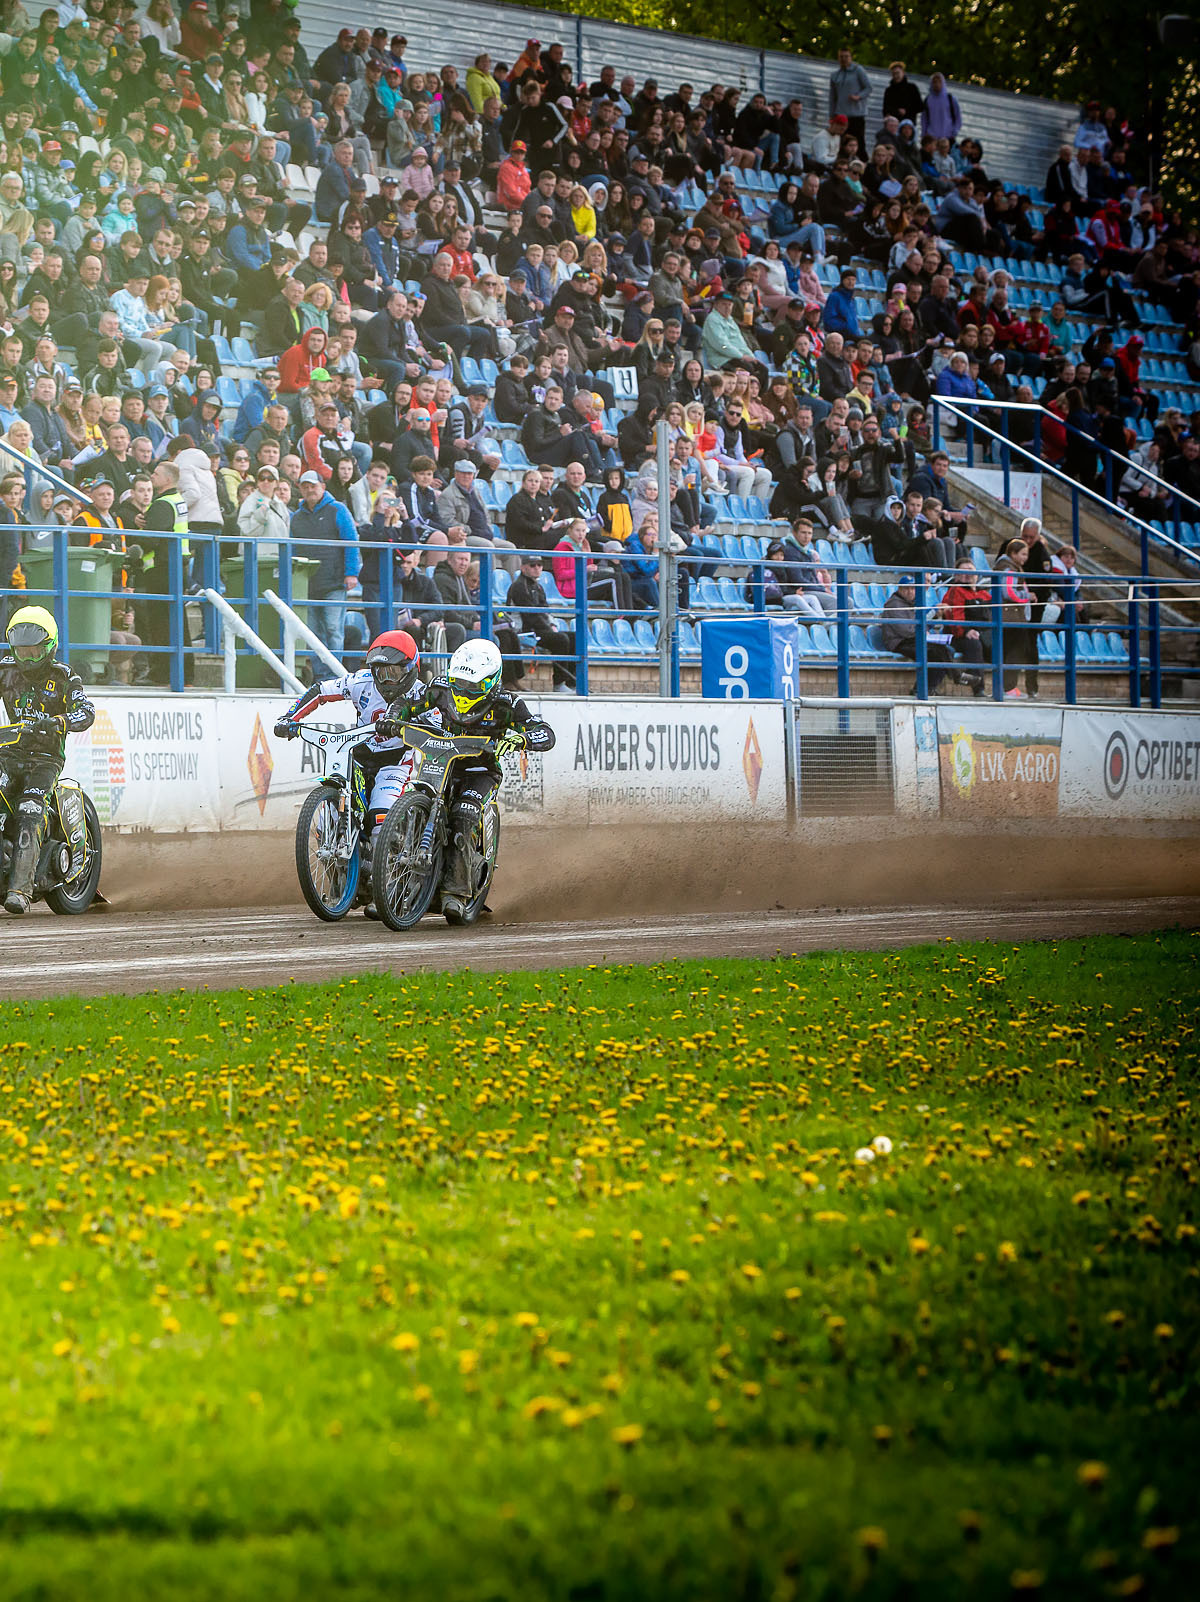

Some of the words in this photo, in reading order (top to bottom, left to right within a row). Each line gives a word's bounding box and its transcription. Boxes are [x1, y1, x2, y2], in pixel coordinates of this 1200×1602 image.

[128, 711, 202, 741] DAUGAVPILS
[330, 735, 360, 743] OPTIBET
[574, 724, 640, 771] AMBER
[645, 724, 720, 771] STUDIOS
[1135, 739, 1200, 781] OPTIBET
[129, 753, 140, 781] IS
[144, 753, 199, 781] SPEEDWAY
[422, 764, 445, 773] ACDC
[980, 752, 1007, 782] LVK
[1013, 752, 1057, 783] AGRO
[460, 802, 480, 813] DPV
